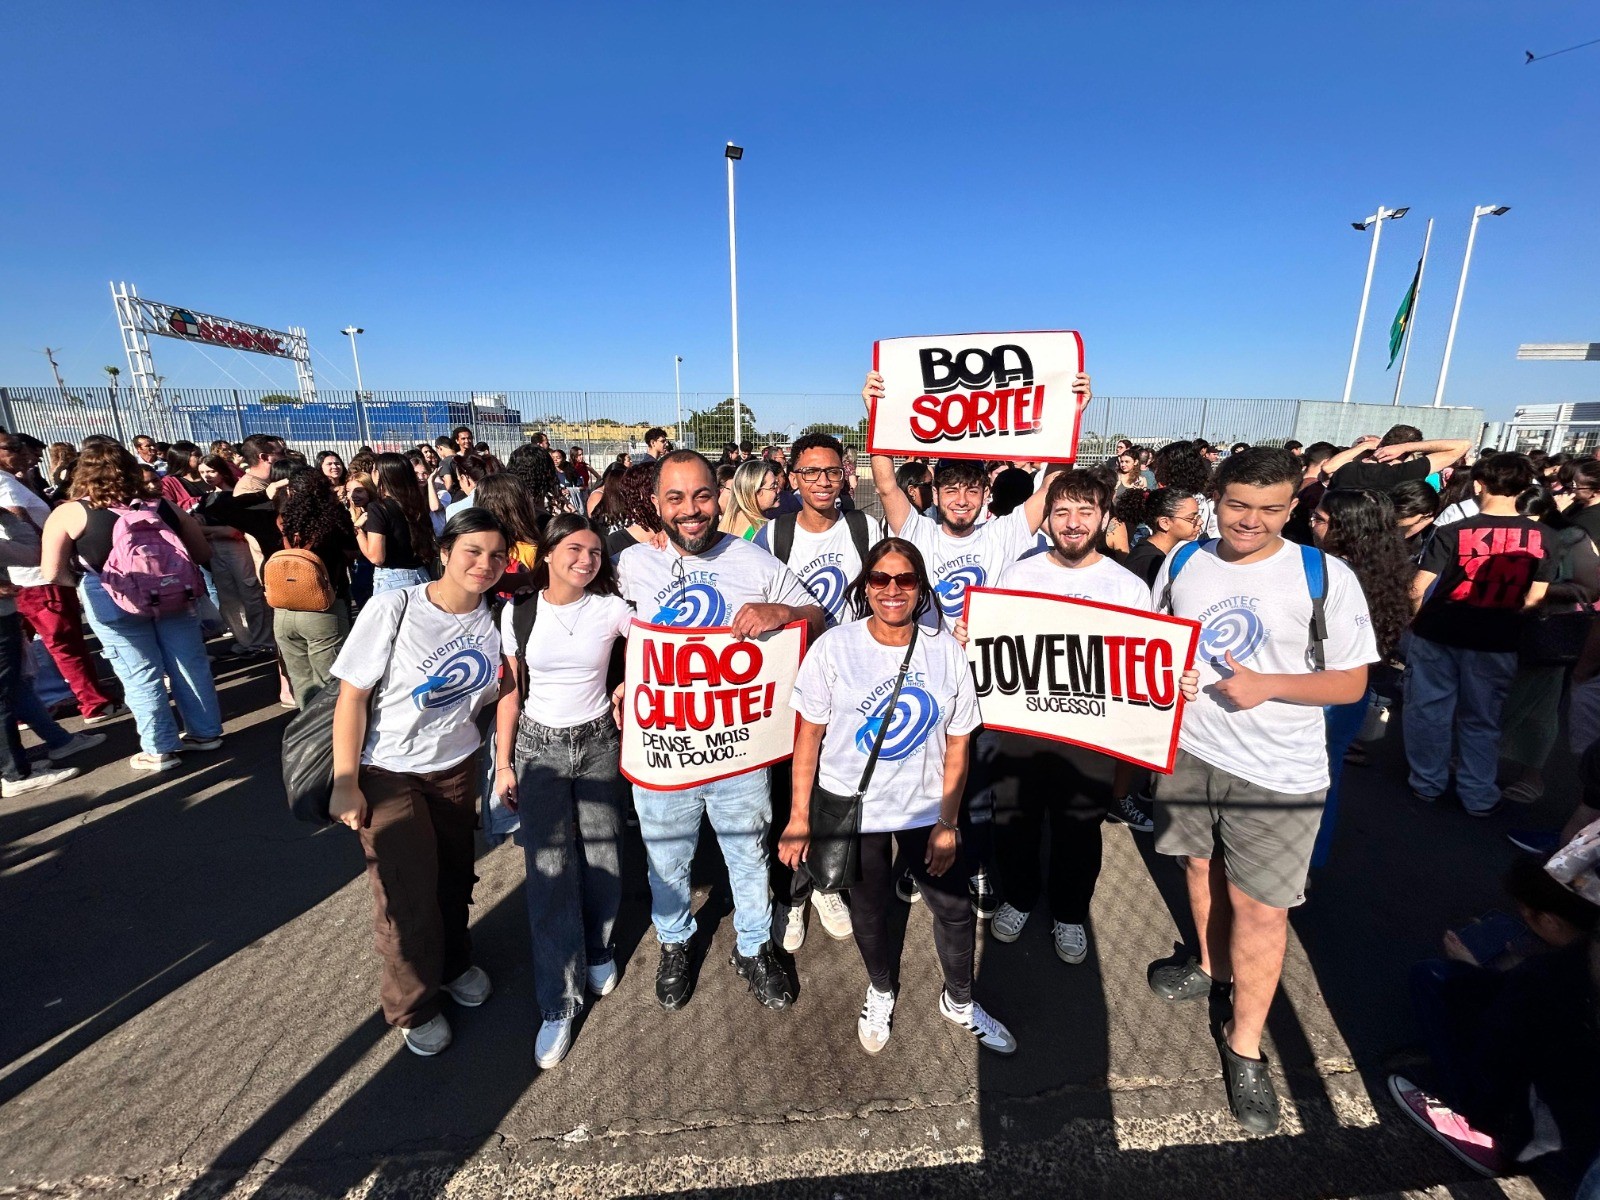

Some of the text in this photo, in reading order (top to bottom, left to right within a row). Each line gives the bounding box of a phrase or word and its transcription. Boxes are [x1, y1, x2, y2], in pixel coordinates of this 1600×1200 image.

[918, 344, 1034, 394] BOA
[909, 384, 1046, 444] SORTE!
[1457, 527, 1545, 559] KILL
[1198, 595, 1260, 622] ovemTEC
[642, 636, 764, 688] NÃO
[633, 681, 776, 732] CHUTE!
[1025, 696, 1107, 718] SUCESSO!
[642, 728, 750, 753] PENSE MAIS
[646, 746, 747, 769] UM POUCO...
